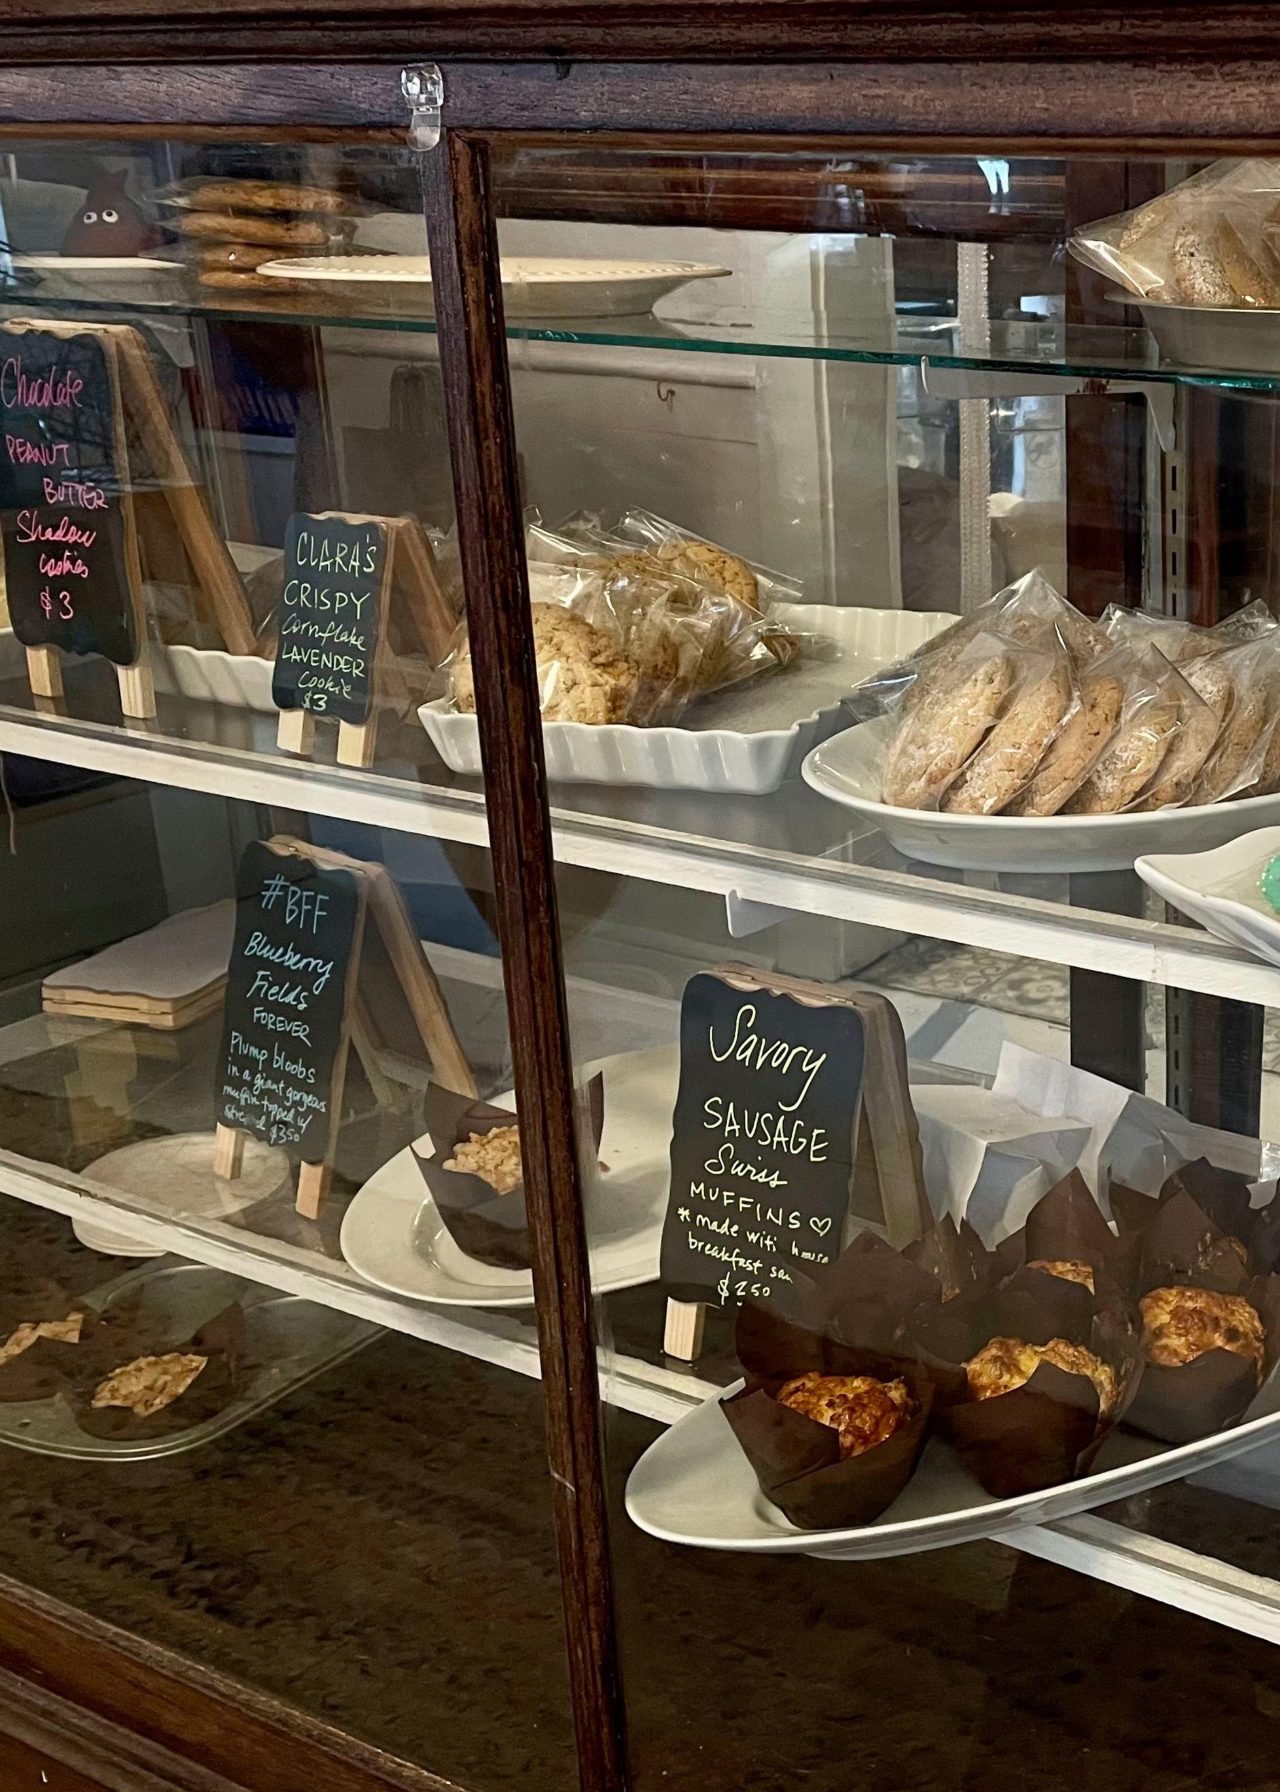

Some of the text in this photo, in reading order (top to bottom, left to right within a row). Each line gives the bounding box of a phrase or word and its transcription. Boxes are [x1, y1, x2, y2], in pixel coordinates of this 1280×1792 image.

[5, 434, 70, 467] PEANUT
[43, 477, 109, 510] BUTTER
[296, 532, 377, 577] CLARA'S
[284, 580, 371, 620] CRISPY
[282, 642, 365, 678] LAVENDER
[301, 690, 328, 711] $3
[261, 873, 329, 934] #BFF
[244, 931, 333, 995] Blueberry
[247, 970, 308, 1011] Fields
[253, 1007, 311, 1047] FOREVER
[227, 1056, 240, 1077] in
[242, 1069, 251, 1081] a
[252, 1073, 285, 1095] giant
[231, 1030, 315, 1083] Plump bloobs
[709, 1003, 827, 1112] Savory
[703, 1096, 829, 1162] SAUSAGE
[704, 1143, 788, 1188] Swiss
[690, 1181, 801, 1229] MUFFINS
[688, 1230, 763, 1275] breakfast
